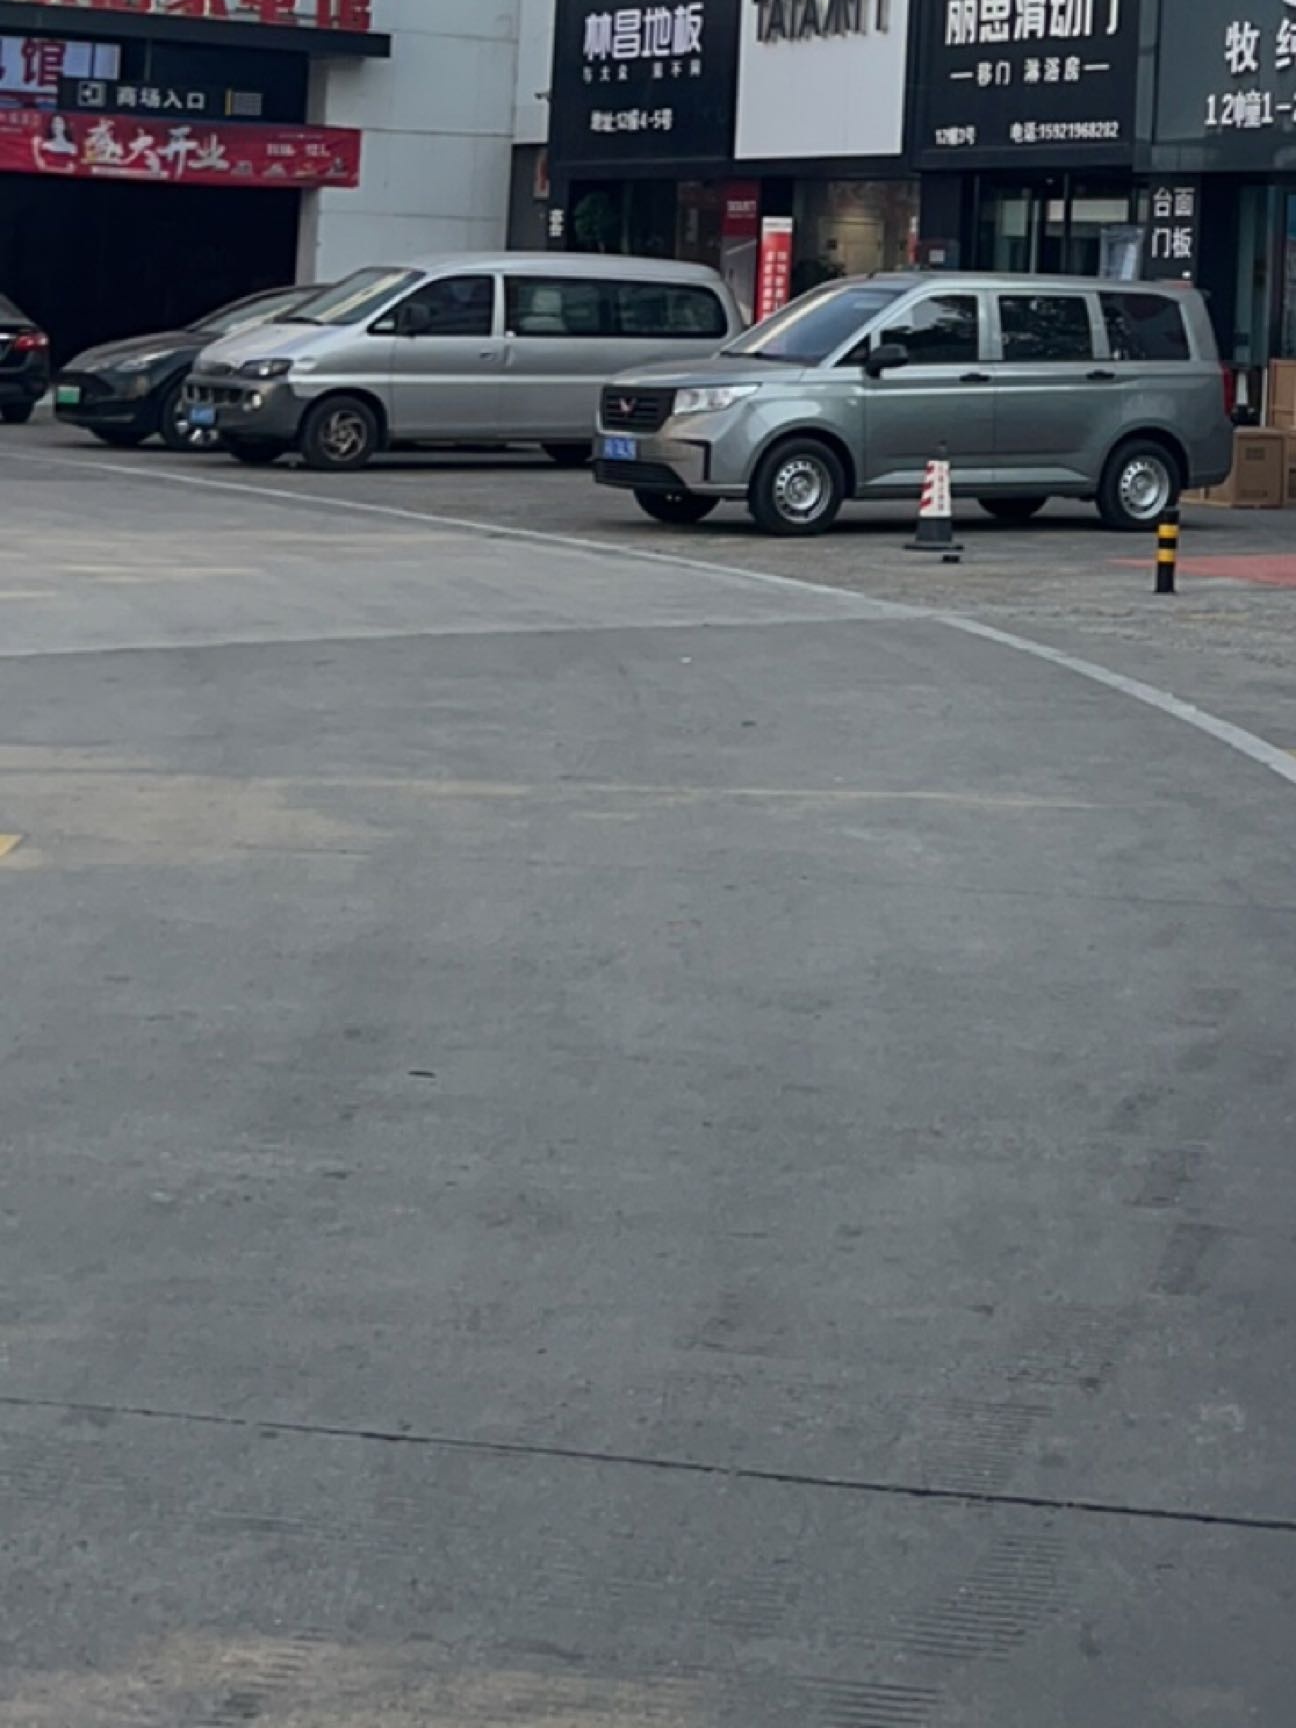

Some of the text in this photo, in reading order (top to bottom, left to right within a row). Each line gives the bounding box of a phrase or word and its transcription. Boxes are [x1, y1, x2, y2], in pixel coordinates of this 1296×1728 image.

[583, 2, 704, 61] 林昌地板
[116, 84, 206, 110] 商场入口
[1152, 186, 1195, 218] 台面
[1151, 226, 1193, 259] 门板
